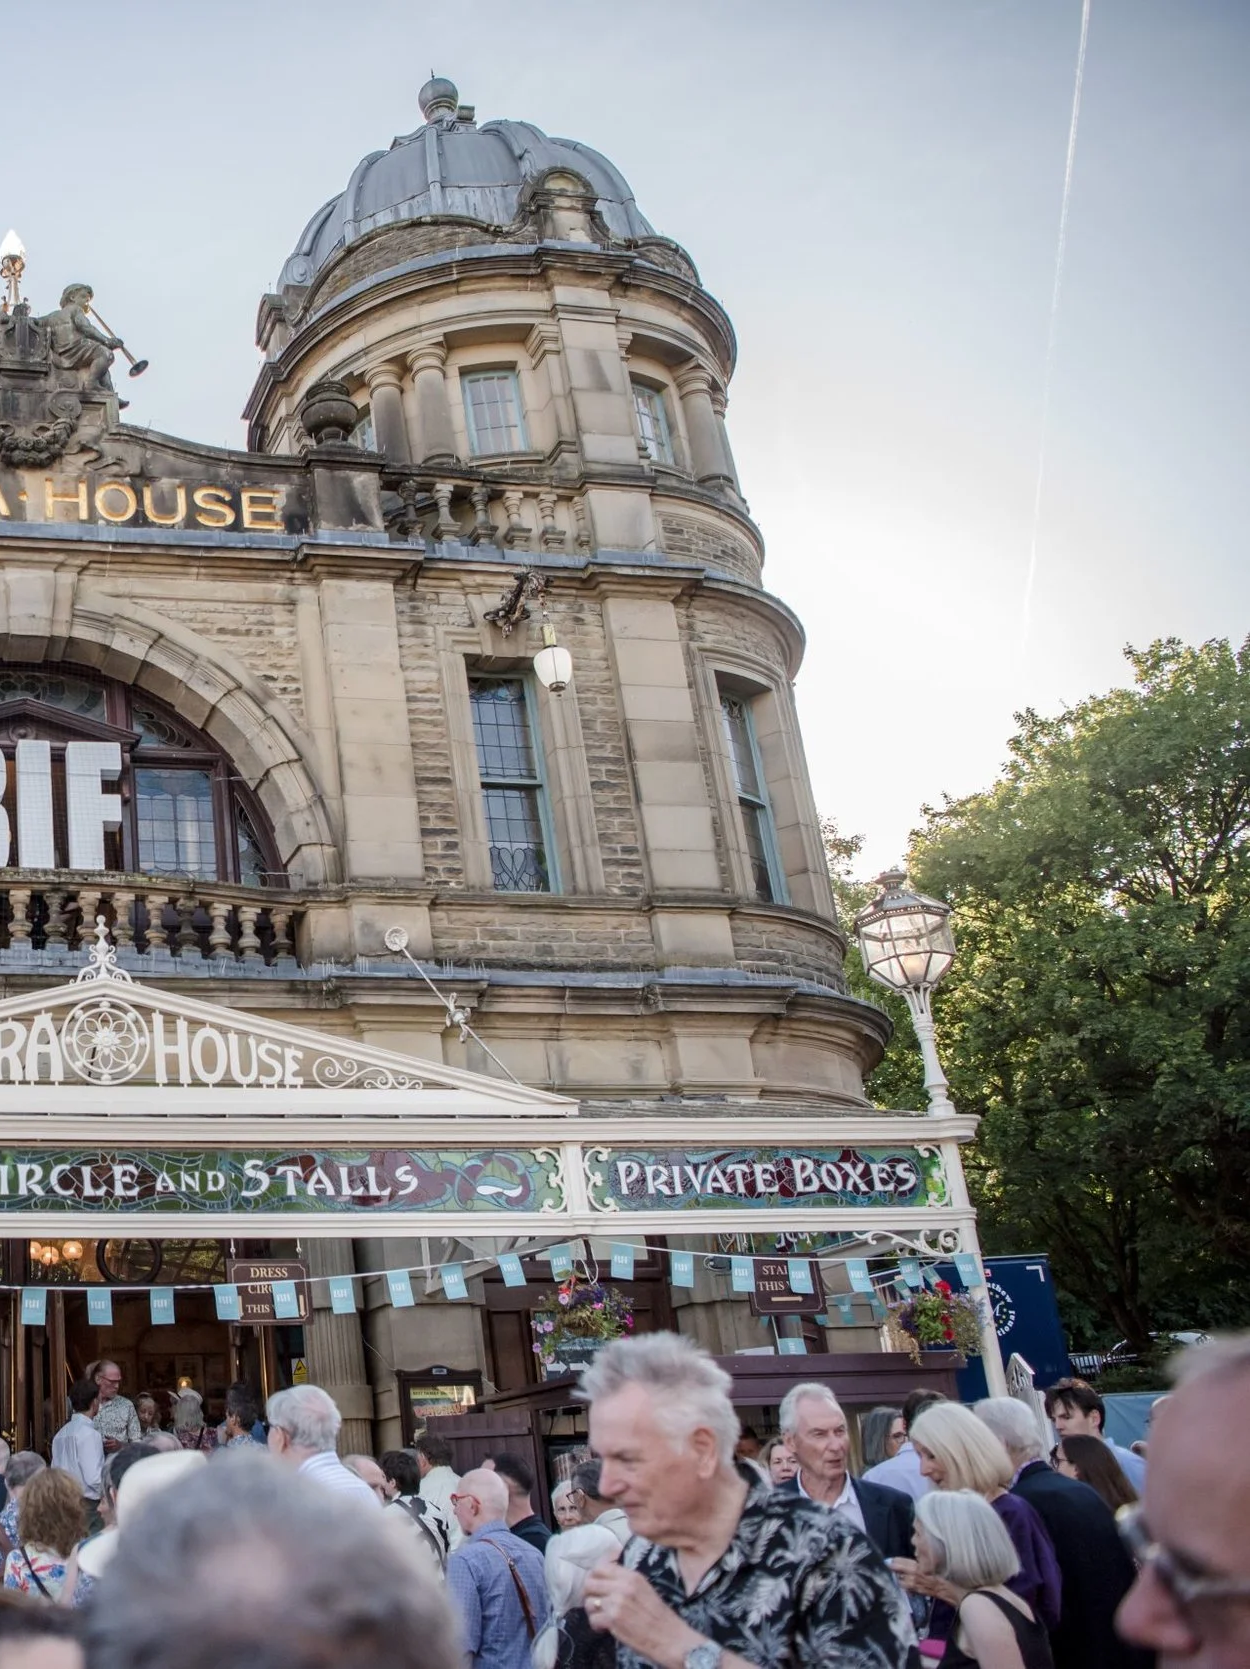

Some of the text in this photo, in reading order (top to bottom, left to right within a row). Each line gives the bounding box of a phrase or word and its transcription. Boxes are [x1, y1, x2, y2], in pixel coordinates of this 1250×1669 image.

[44, 477, 286, 530] HOUSE
[151, 1011, 304, 1085] HOUSE
[155, 1170, 226, 1192] AND
[240, 1159, 419, 1197] STALLS
[615, 1158, 918, 1195] PRIVATE BOXES
[250, 1267, 288, 1278] DRESS
[757, 1281, 785, 1291] THIS
[246, 1304, 270, 1314] THIS
